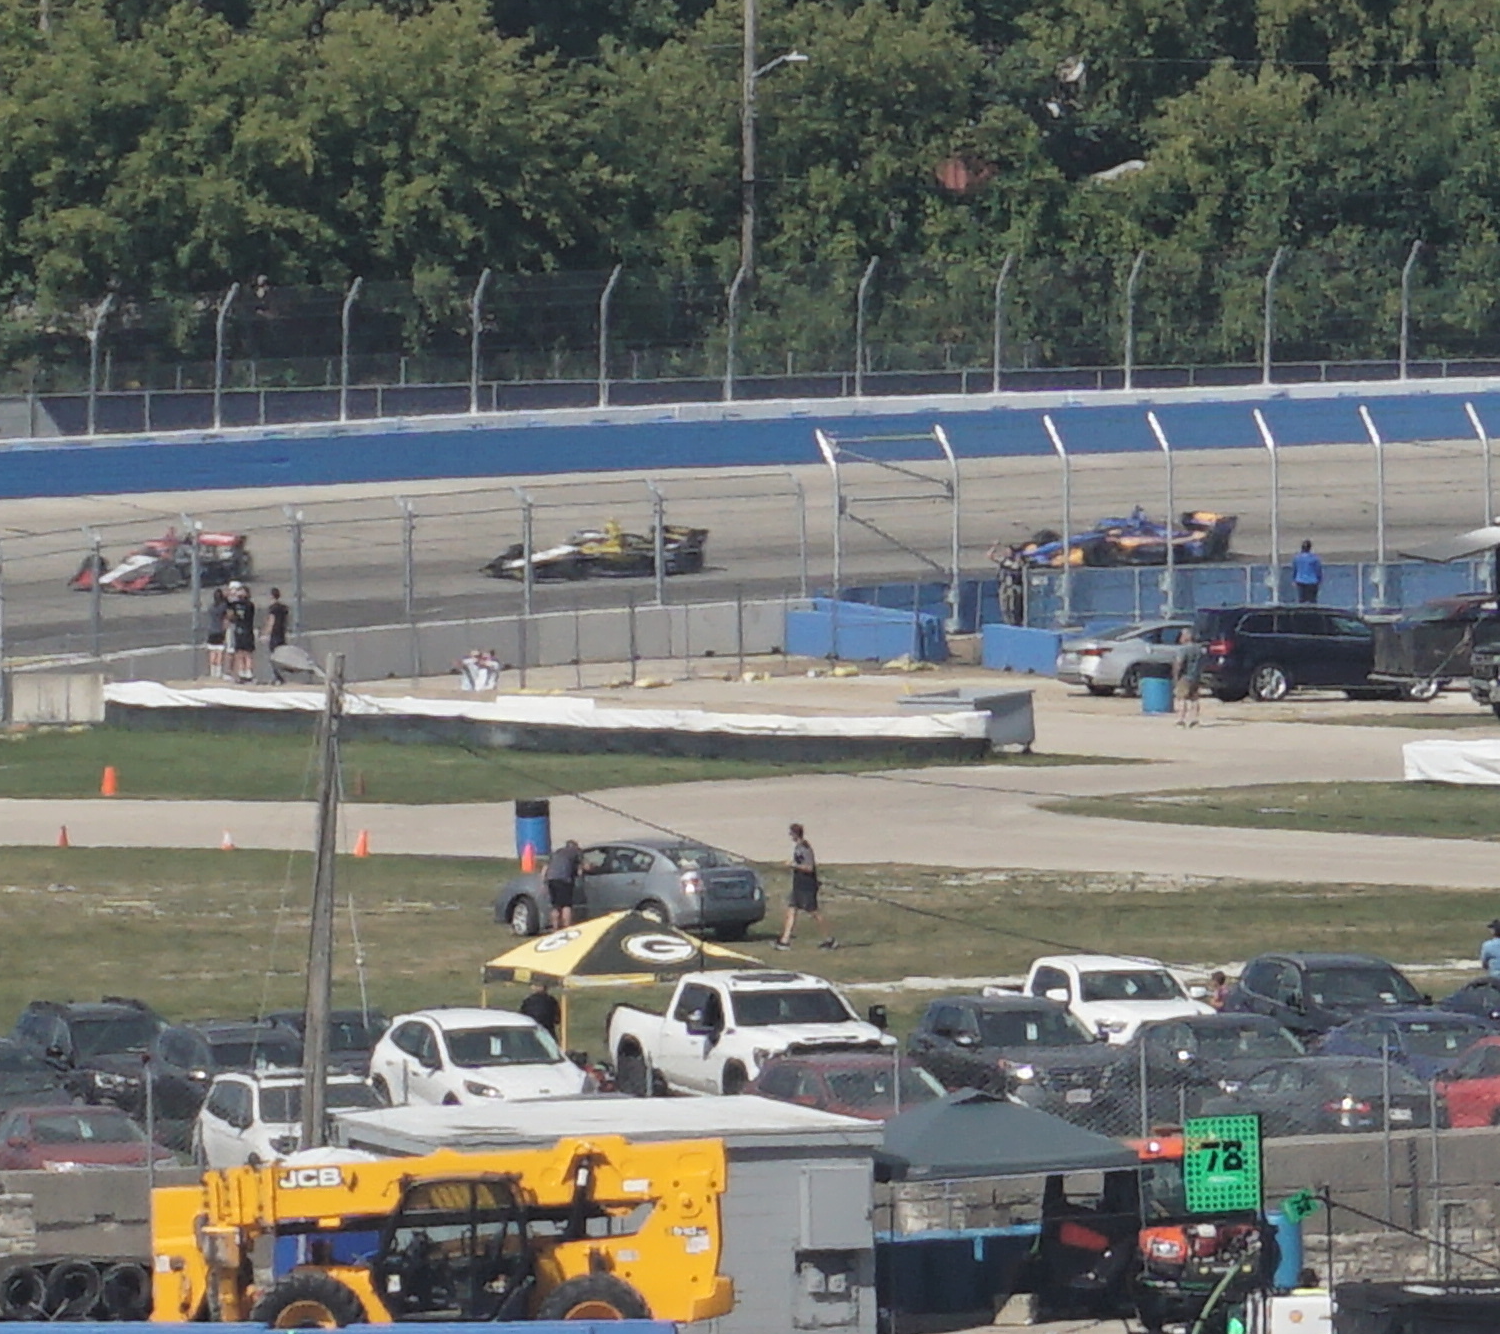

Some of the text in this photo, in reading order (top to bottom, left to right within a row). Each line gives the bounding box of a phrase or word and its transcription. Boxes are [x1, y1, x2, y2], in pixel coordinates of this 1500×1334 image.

[626, 934, 693, 962] G
[1200, 1140, 1243, 1172] 78
[279, 1167, 341, 1188] JCB
